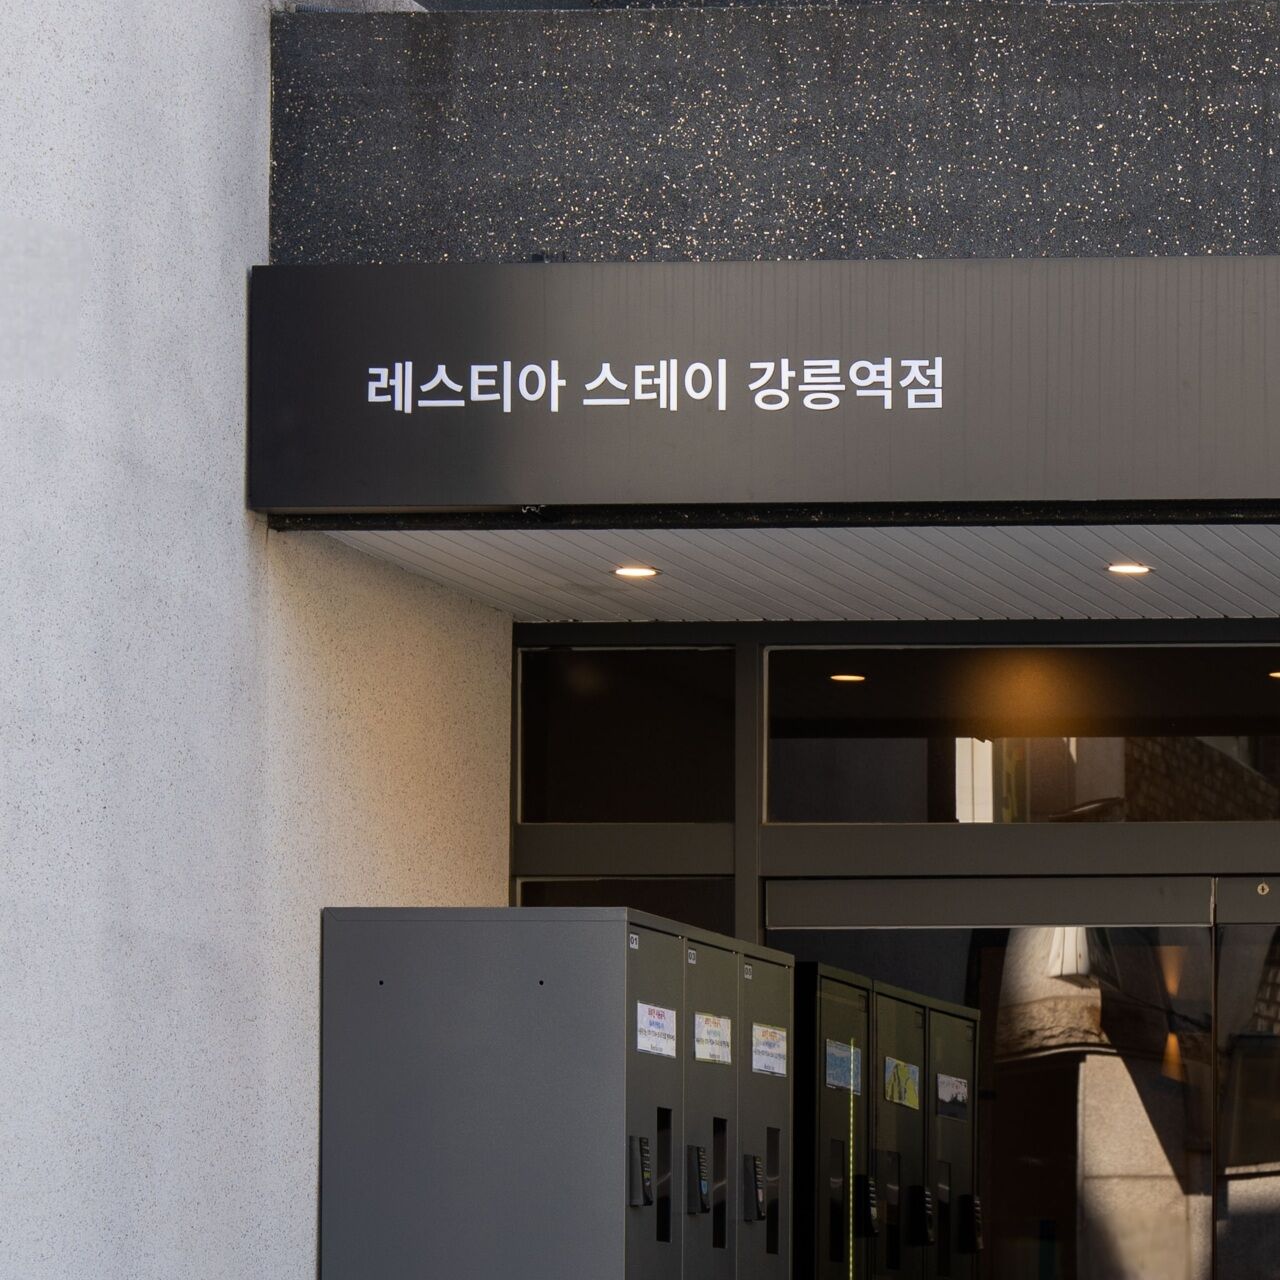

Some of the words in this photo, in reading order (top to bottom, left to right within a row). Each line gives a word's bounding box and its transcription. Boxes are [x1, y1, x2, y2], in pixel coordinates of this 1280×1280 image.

[368, 360, 567, 414] 레스티아
[582, 358, 728, 412] 스테이
[747, 356, 944, 411] 강릉역점
[630, 935, 638, 946] 01
[688, 951, 696, 961] 03
